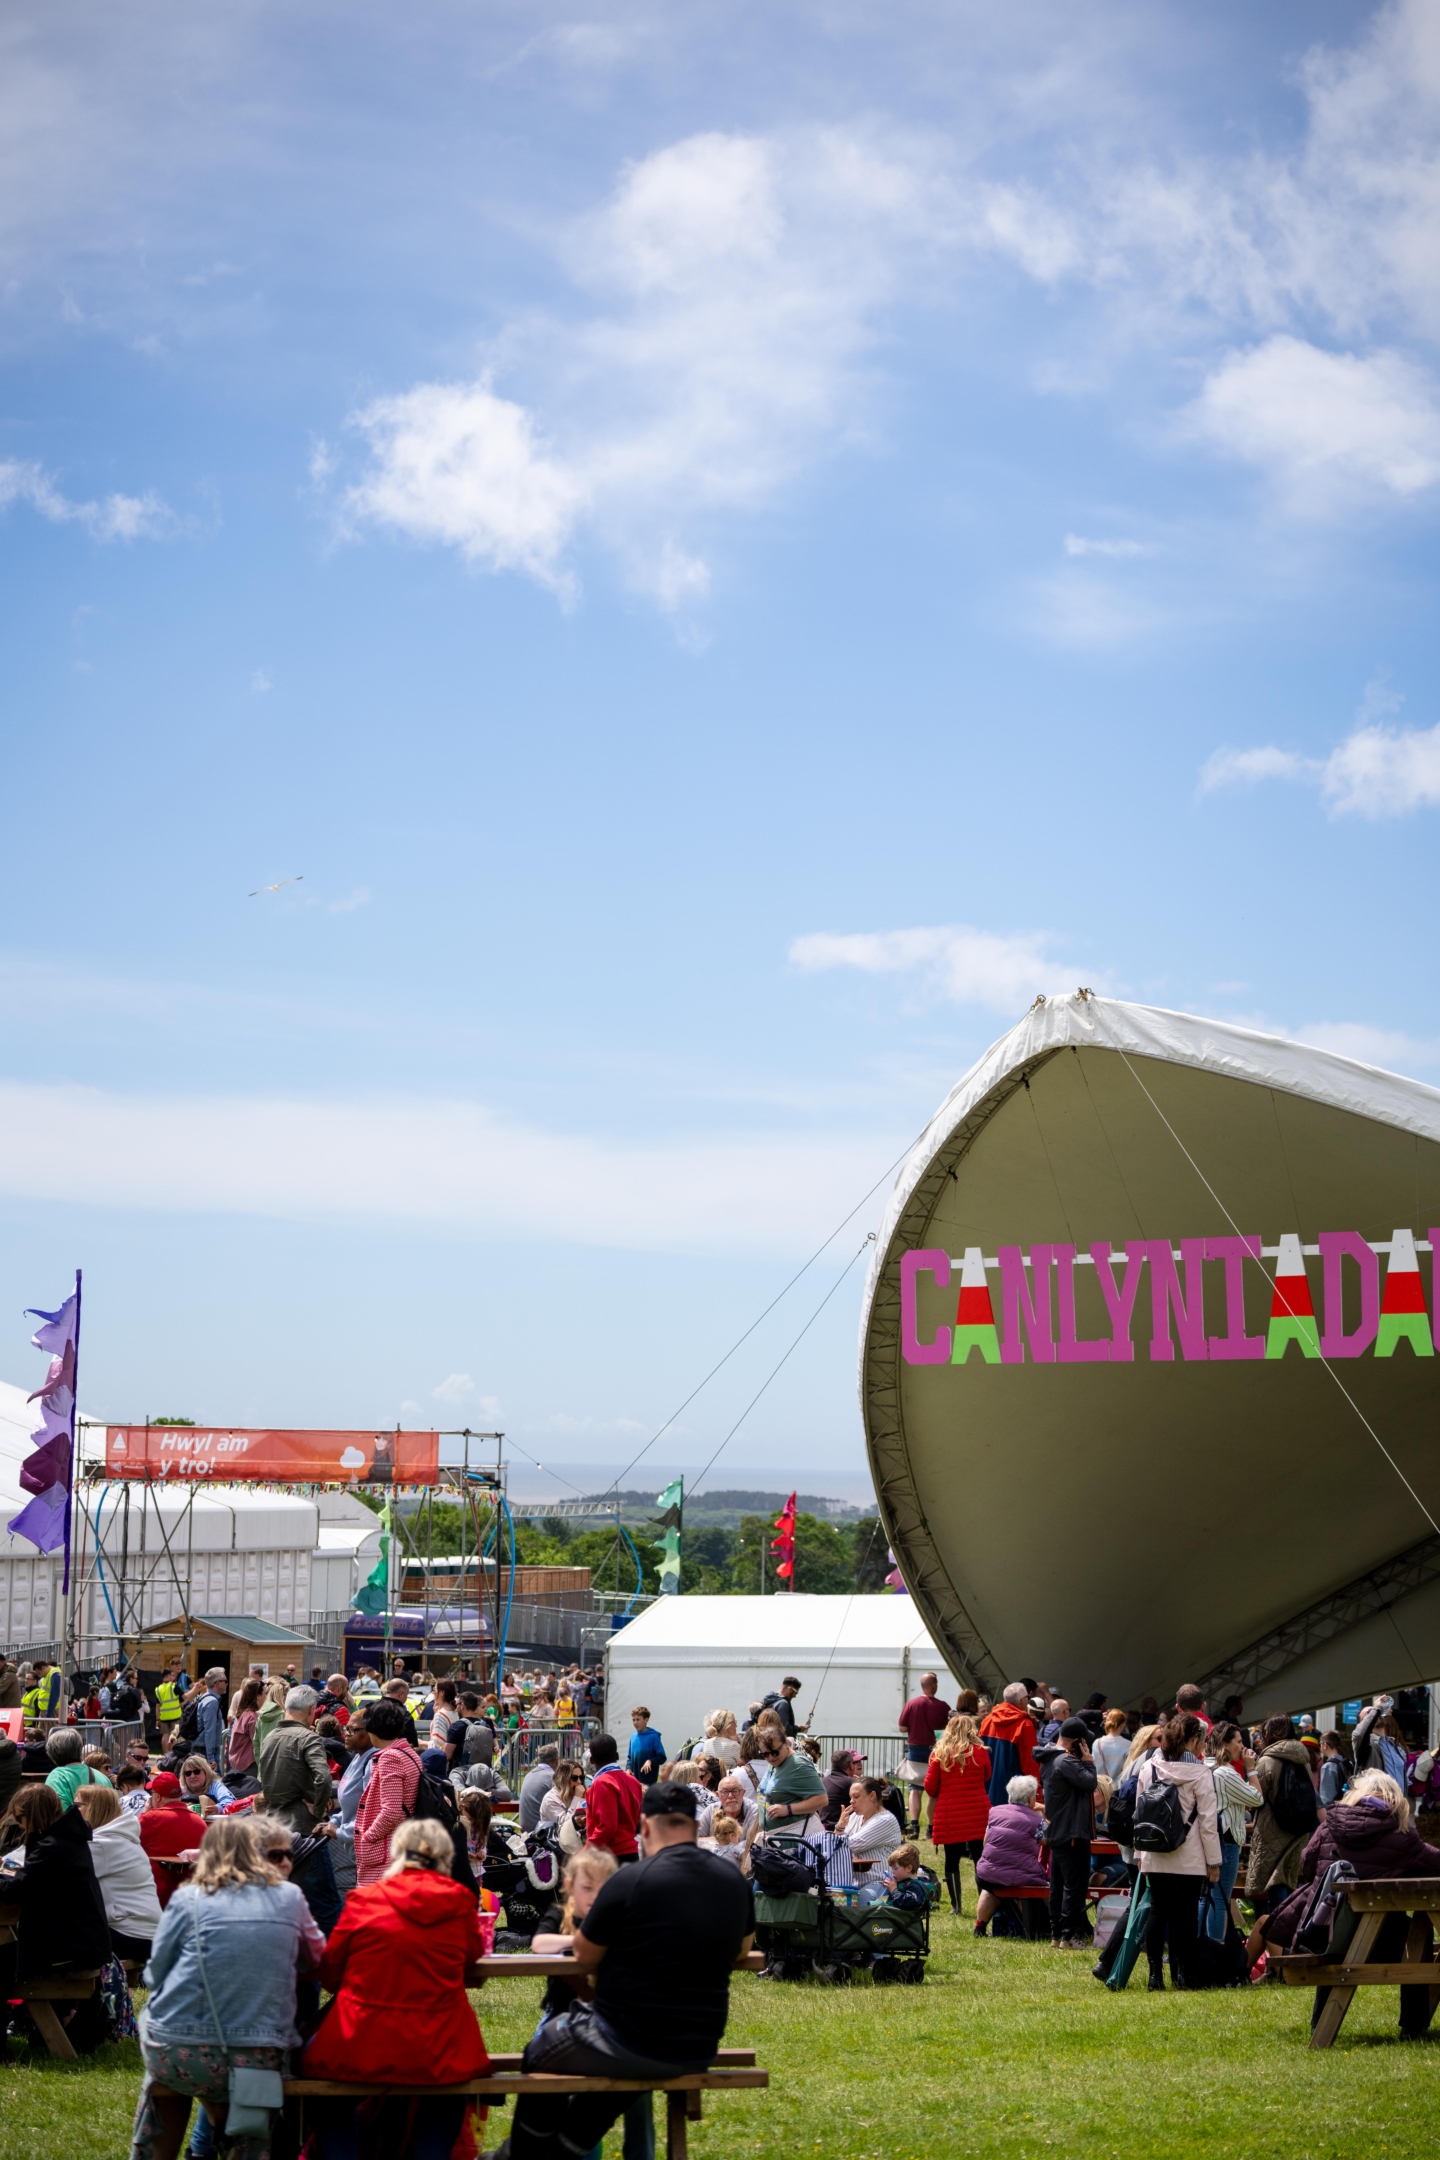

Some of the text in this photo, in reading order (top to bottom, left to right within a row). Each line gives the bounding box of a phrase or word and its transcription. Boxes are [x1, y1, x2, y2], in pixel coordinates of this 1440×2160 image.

[901, 1228, 1440, 1365] CANLYNIADA
[160, 1433, 249, 1454] Hwyl am
[159, 1457, 216, 1477] y tro!
[364, 1619, 407, 1629] ice cam
